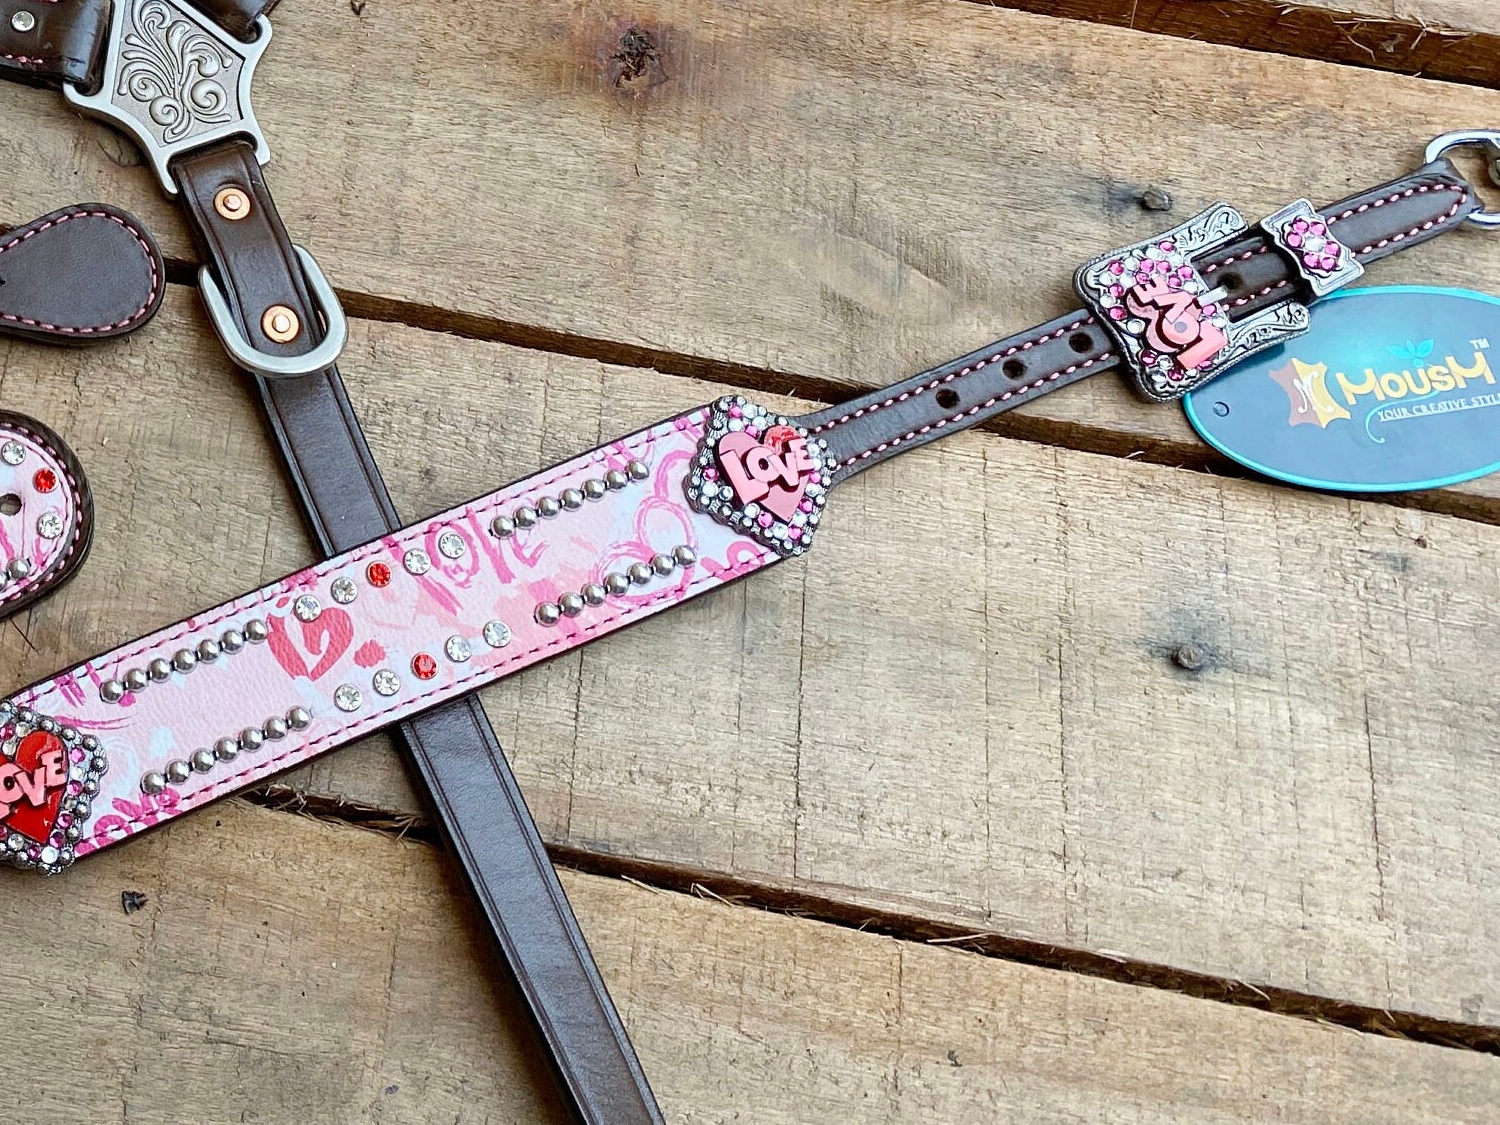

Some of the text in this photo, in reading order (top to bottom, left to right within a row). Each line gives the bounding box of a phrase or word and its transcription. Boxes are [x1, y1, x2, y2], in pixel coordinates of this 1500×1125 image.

[1134, 275, 1229, 370] LOVE
[1377, 407, 1410, 422] YOUR
[1412, 398, 1470, 416] CREATIVE
[719, 435, 815, 505] LOVE
